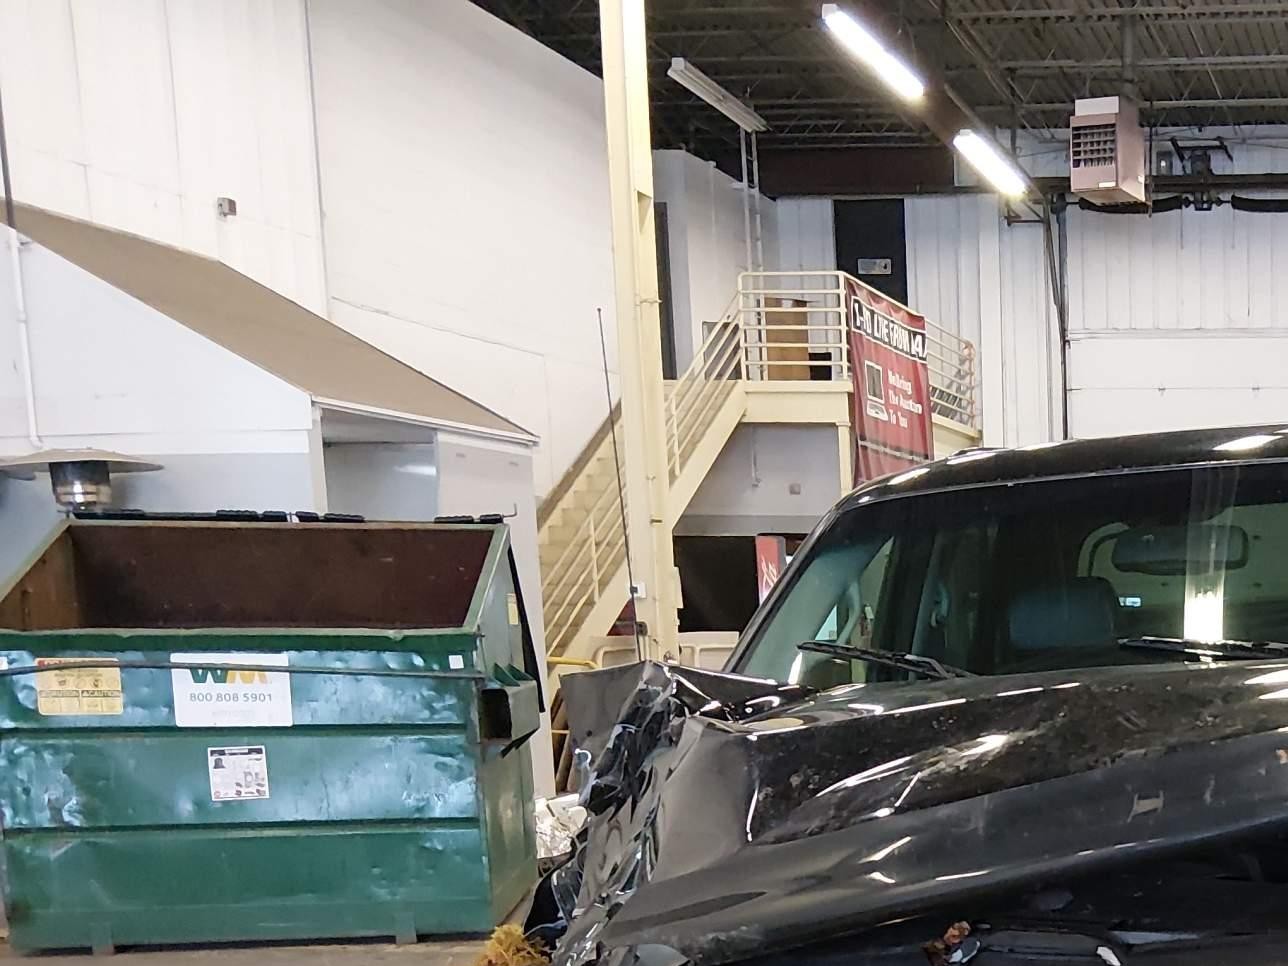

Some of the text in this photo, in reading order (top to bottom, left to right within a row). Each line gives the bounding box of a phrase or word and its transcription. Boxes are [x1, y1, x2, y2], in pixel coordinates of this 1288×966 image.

[189, 692, 273, 703] 800 808 5901
